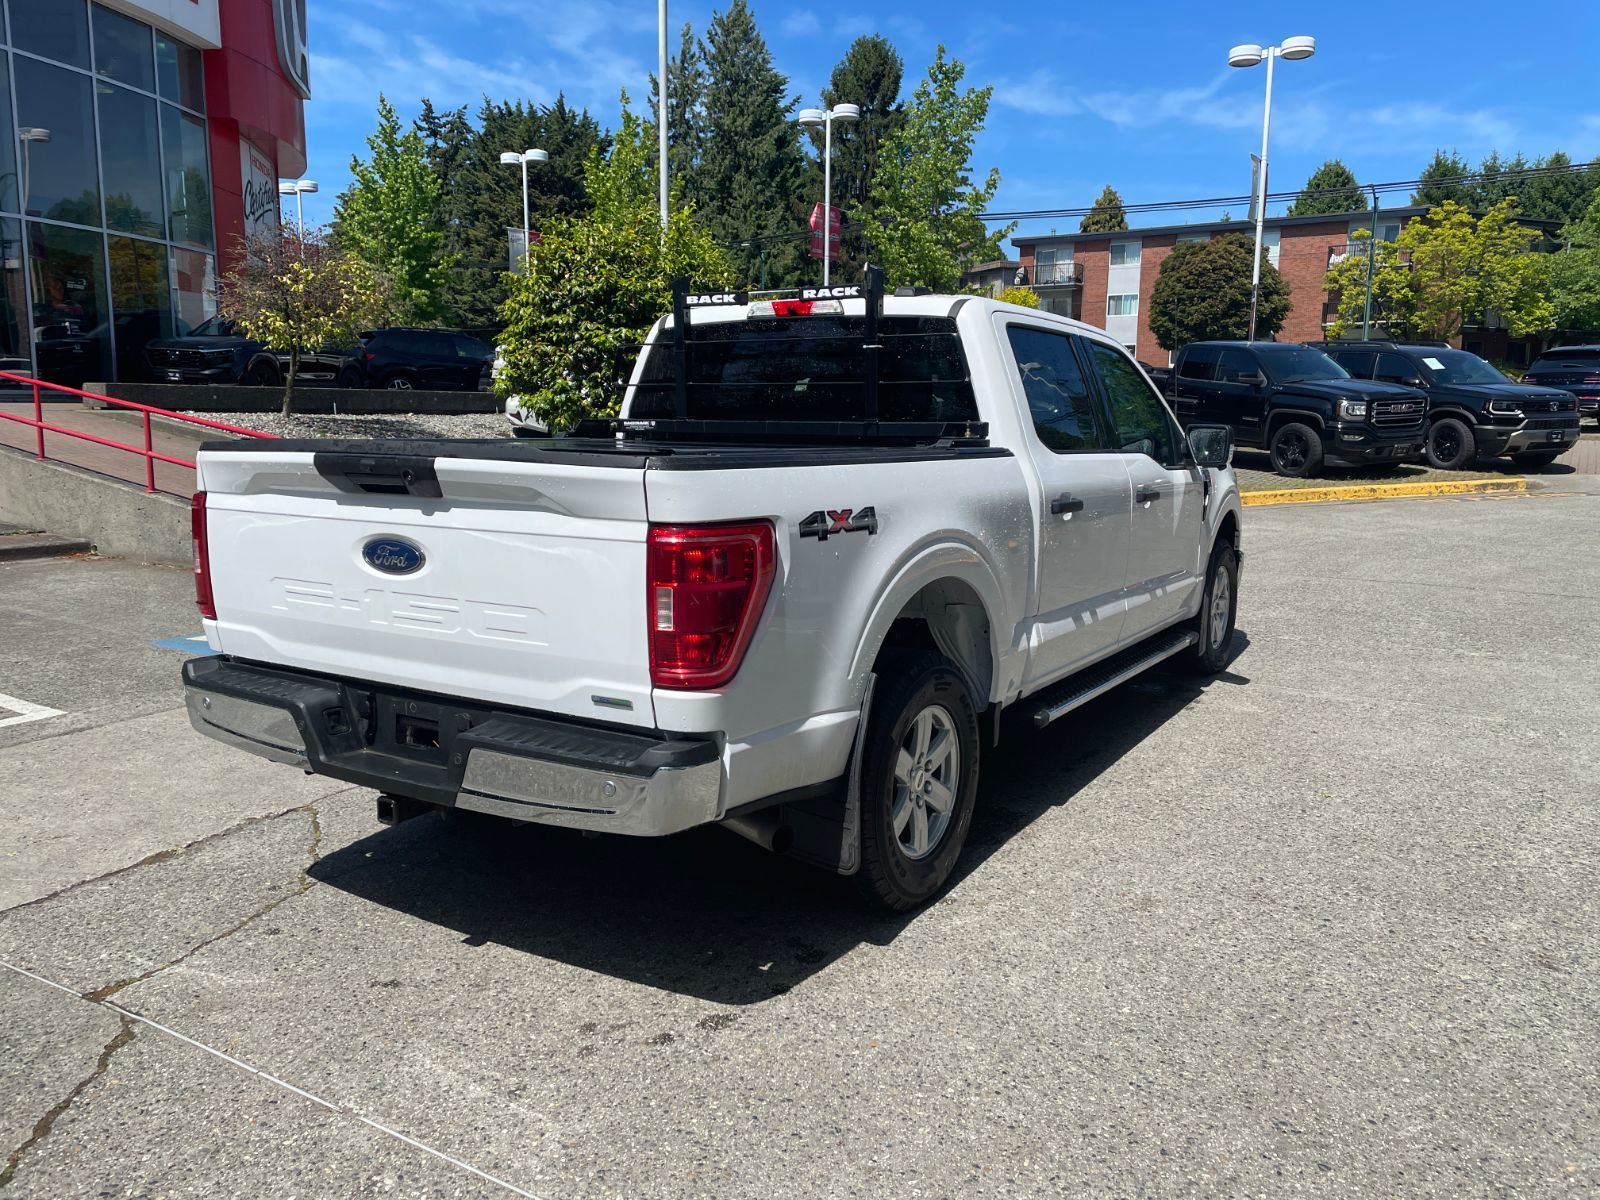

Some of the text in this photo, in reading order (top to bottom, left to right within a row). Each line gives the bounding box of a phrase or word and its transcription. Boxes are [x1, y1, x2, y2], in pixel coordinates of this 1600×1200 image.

[686, 286, 859, 305] BACK RACK
[373, 544, 409, 568] Ford
[270, 576, 549, 646] F-150
